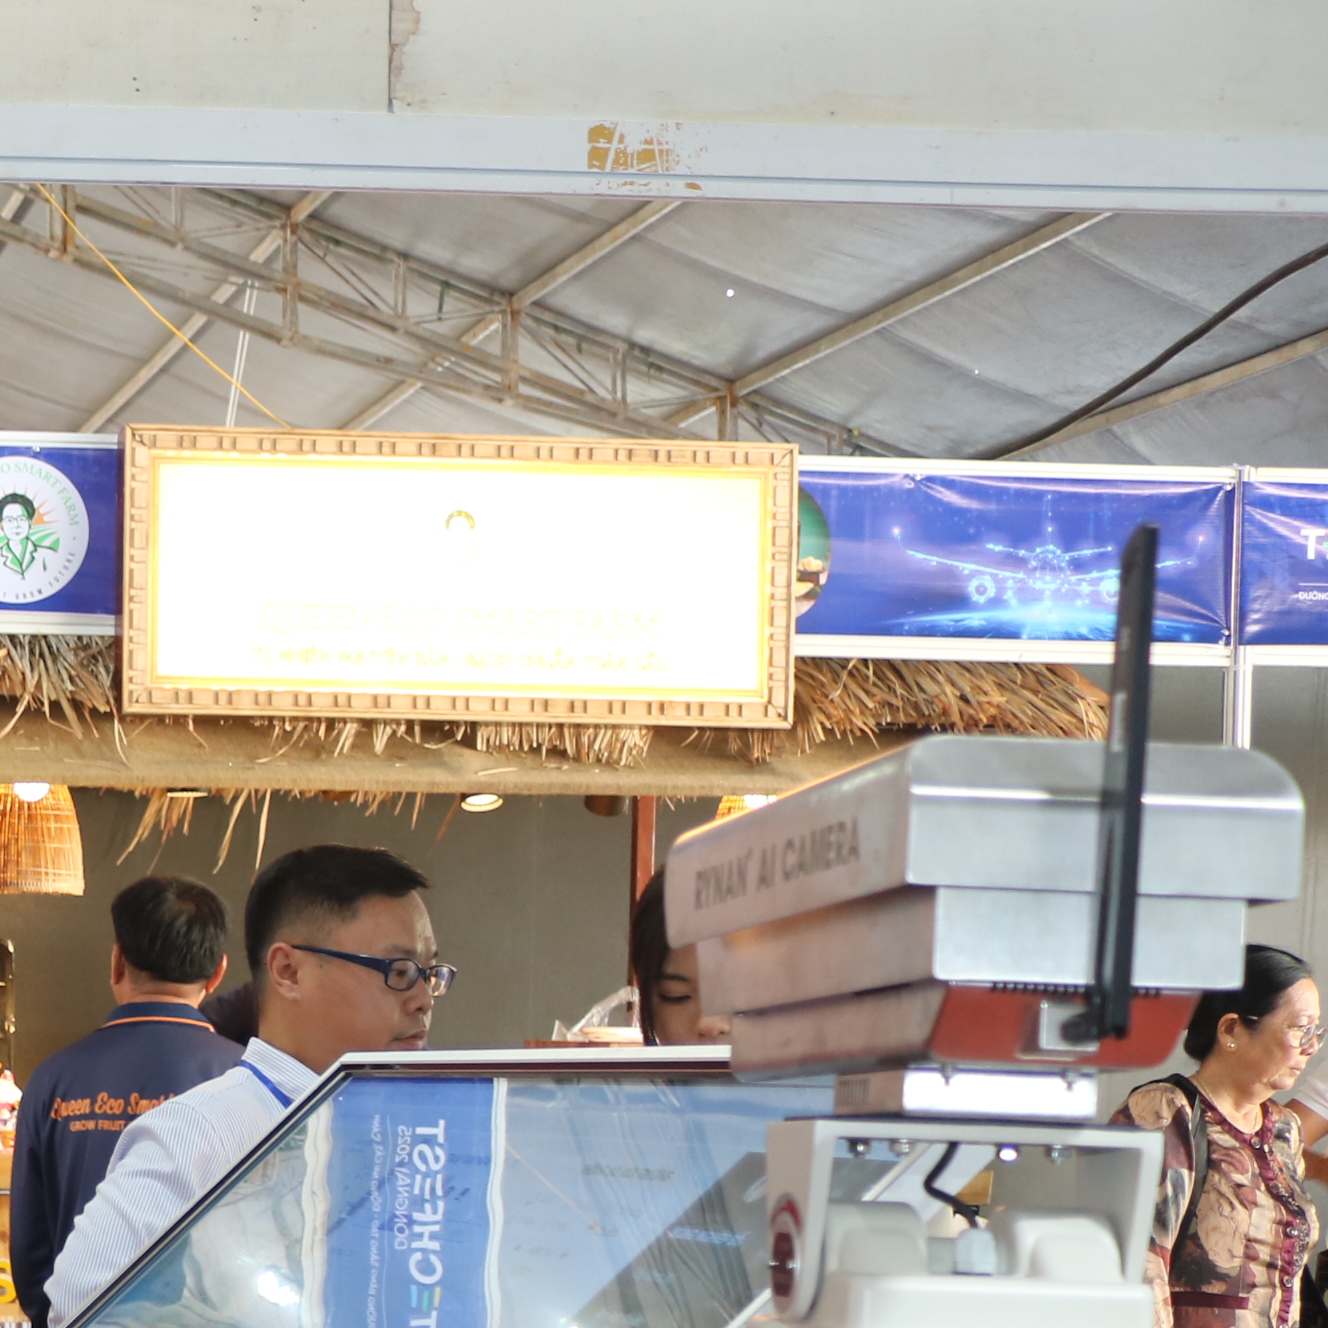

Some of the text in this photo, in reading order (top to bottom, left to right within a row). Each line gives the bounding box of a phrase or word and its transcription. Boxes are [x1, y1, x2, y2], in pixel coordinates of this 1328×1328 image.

[13, 462, 63, 488] SMART
[58, 487, 81, 527] FARM
[756, 843, 777, 891] AI
[781, 816, 861, 882] CAMERA
[50, 1097, 92, 1121] Queen
[94, 1092, 125, 1114] Eco
[69, 1119, 126, 1132] GROW FRUIT
